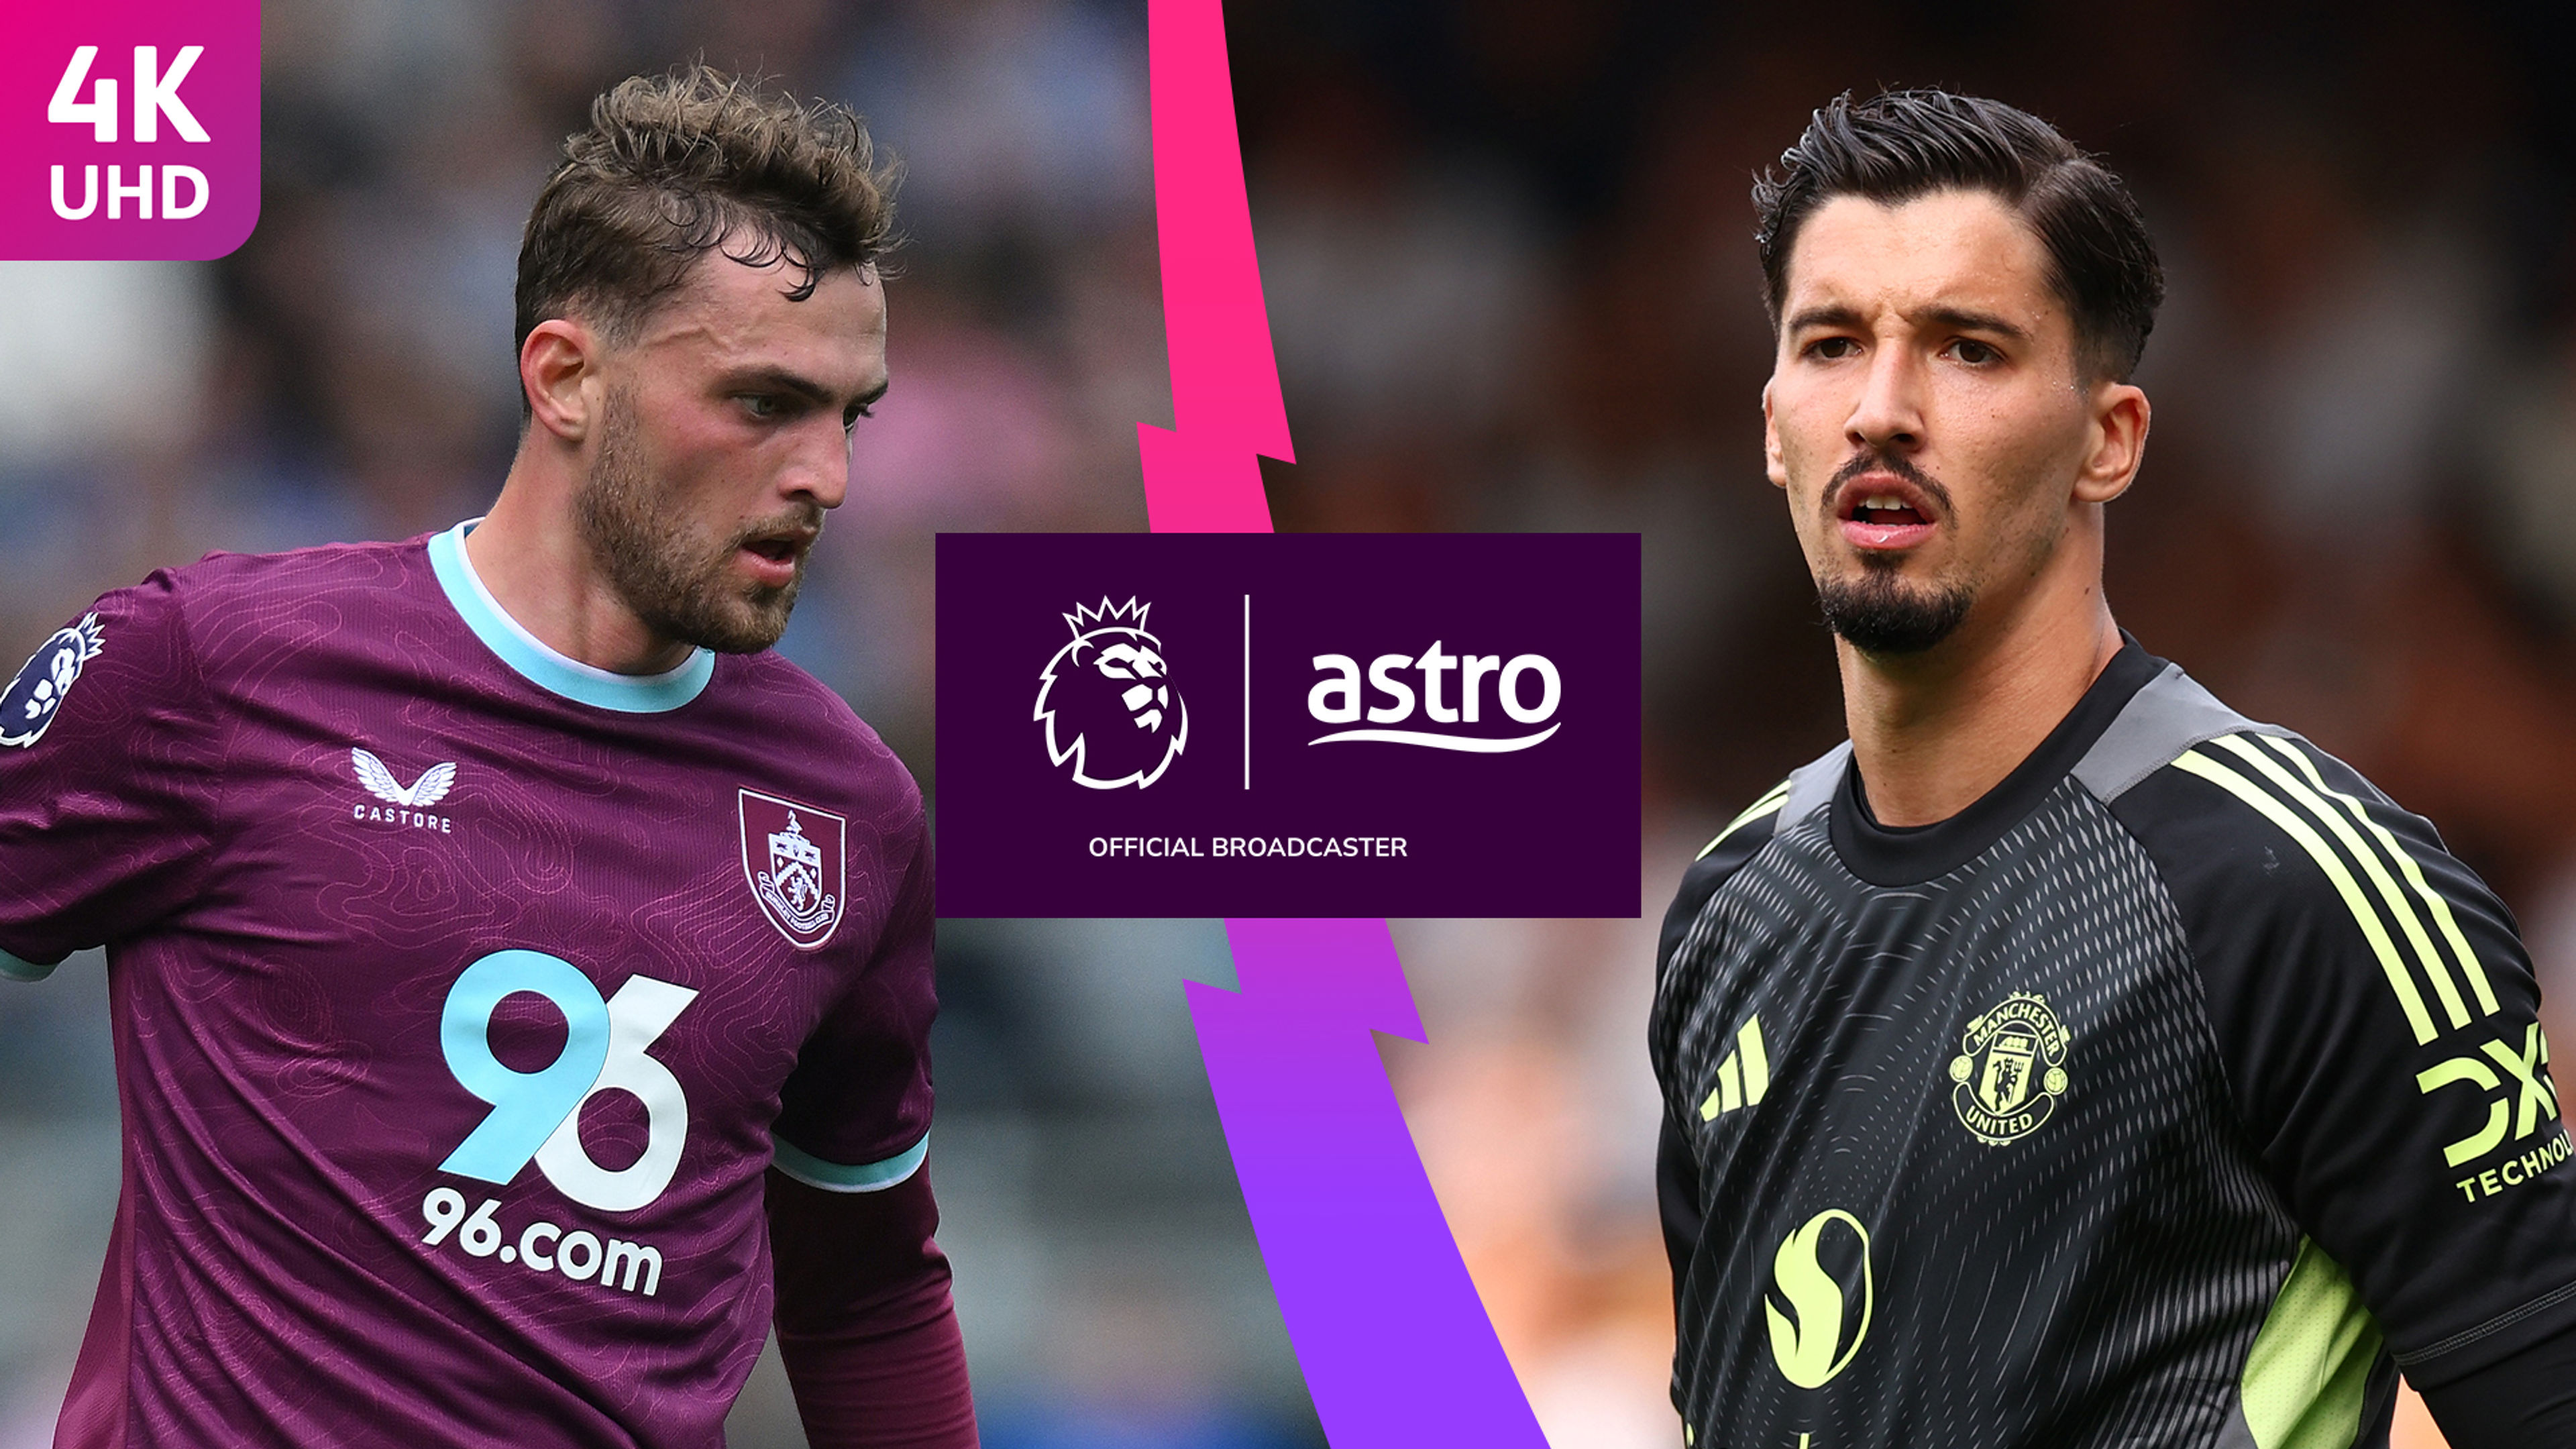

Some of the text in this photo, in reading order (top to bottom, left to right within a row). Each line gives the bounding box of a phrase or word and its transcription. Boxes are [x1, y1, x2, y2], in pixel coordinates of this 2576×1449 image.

[354, 804, 451, 834] CASTORE
[1973, 1003, 2061, 1057] MANCHESTER
[437, 949, 700, 1212] 96
[2416, 1022, 2558, 1168] DX
[1966, 1106, 2033, 1135] UNITED
[2456, 1128, 2574, 1203] TECHNOL
[421, 1187, 663, 1296] 96.com
